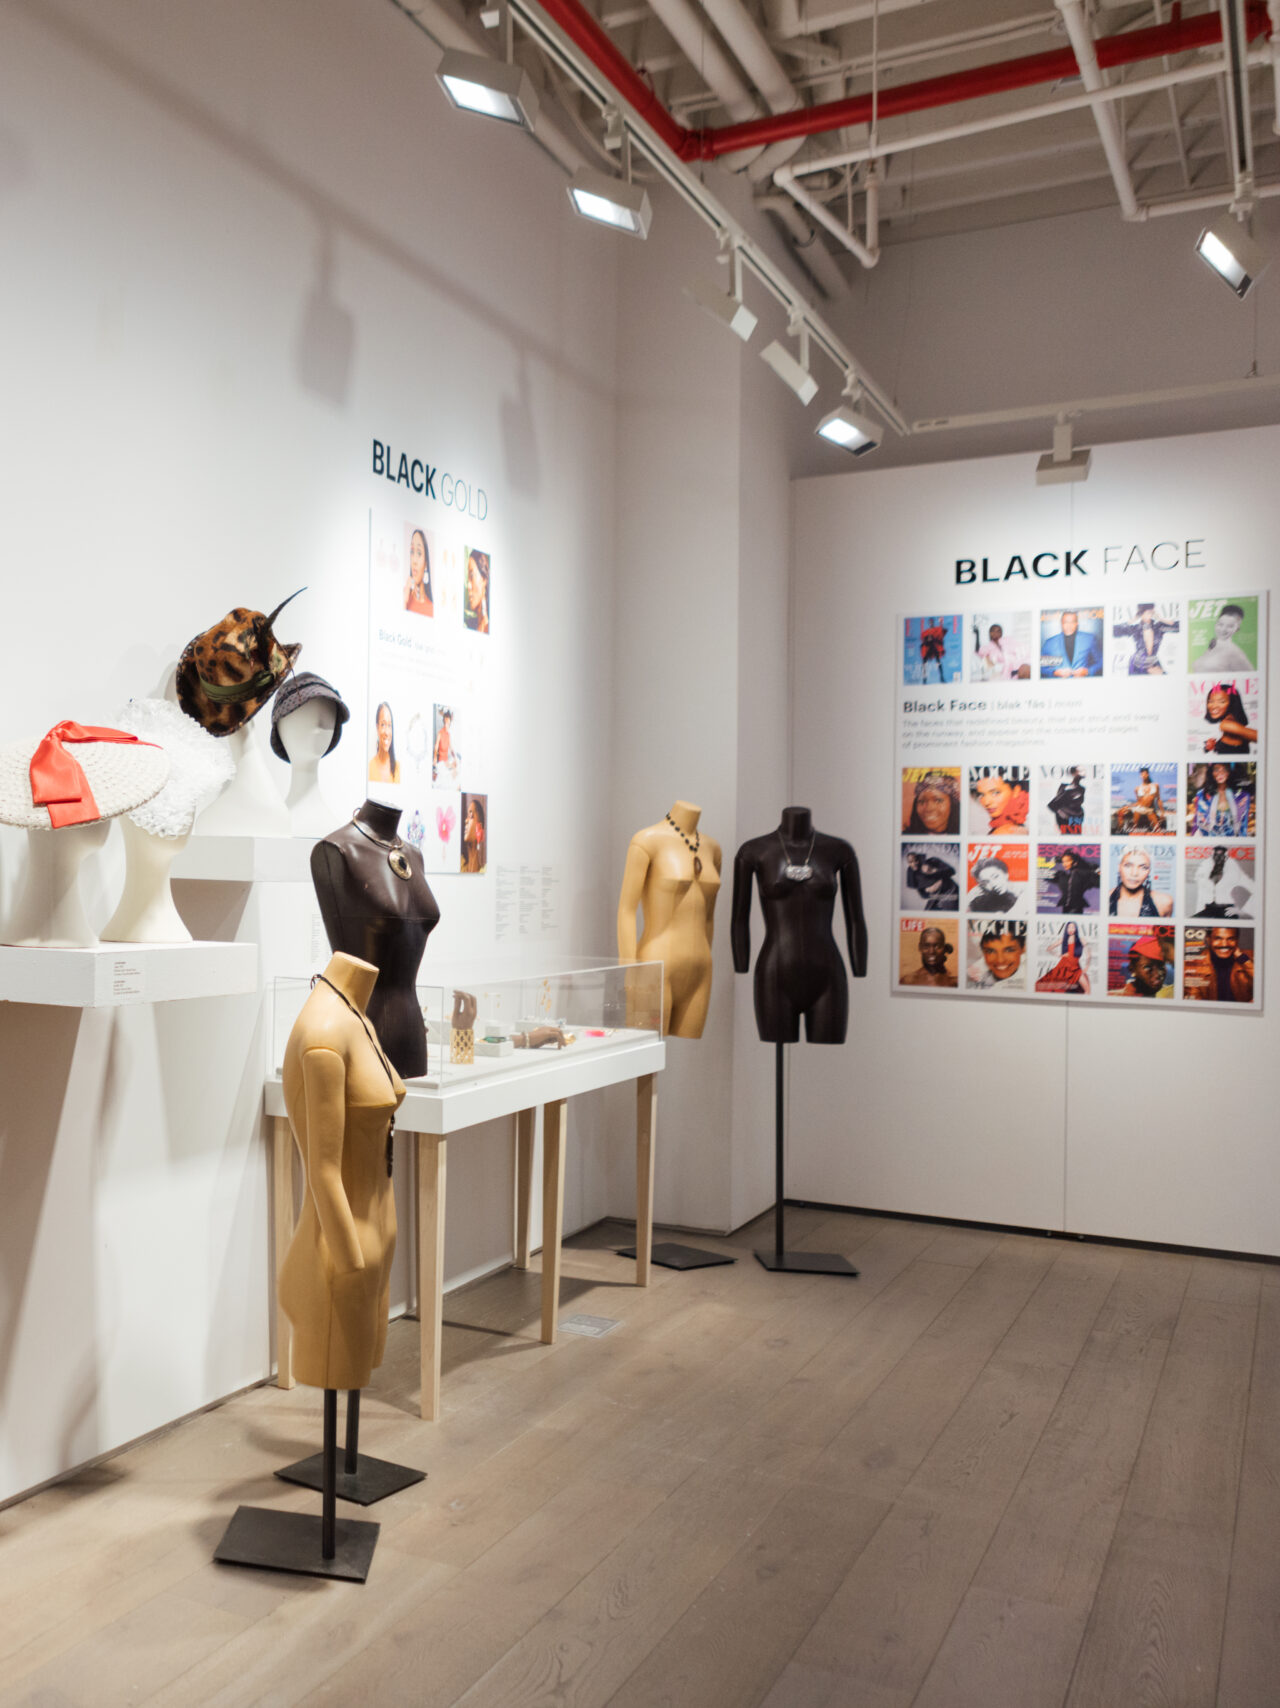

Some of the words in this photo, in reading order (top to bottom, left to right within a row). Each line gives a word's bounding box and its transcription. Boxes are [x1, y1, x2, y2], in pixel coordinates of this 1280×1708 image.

[372, 438, 437, 500] BLACK
[440, 472, 488, 521] GOLD
[954, 549, 1089, 585] BLACK
[1103, 539, 1207, 574] FACE
[903, 699, 945, 713] Black
[950, 699, 987, 711] Face
[968, 845, 1002, 861] JET
[902, 920, 924, 932] LIFE
[1185, 929, 1207, 939] GQ
